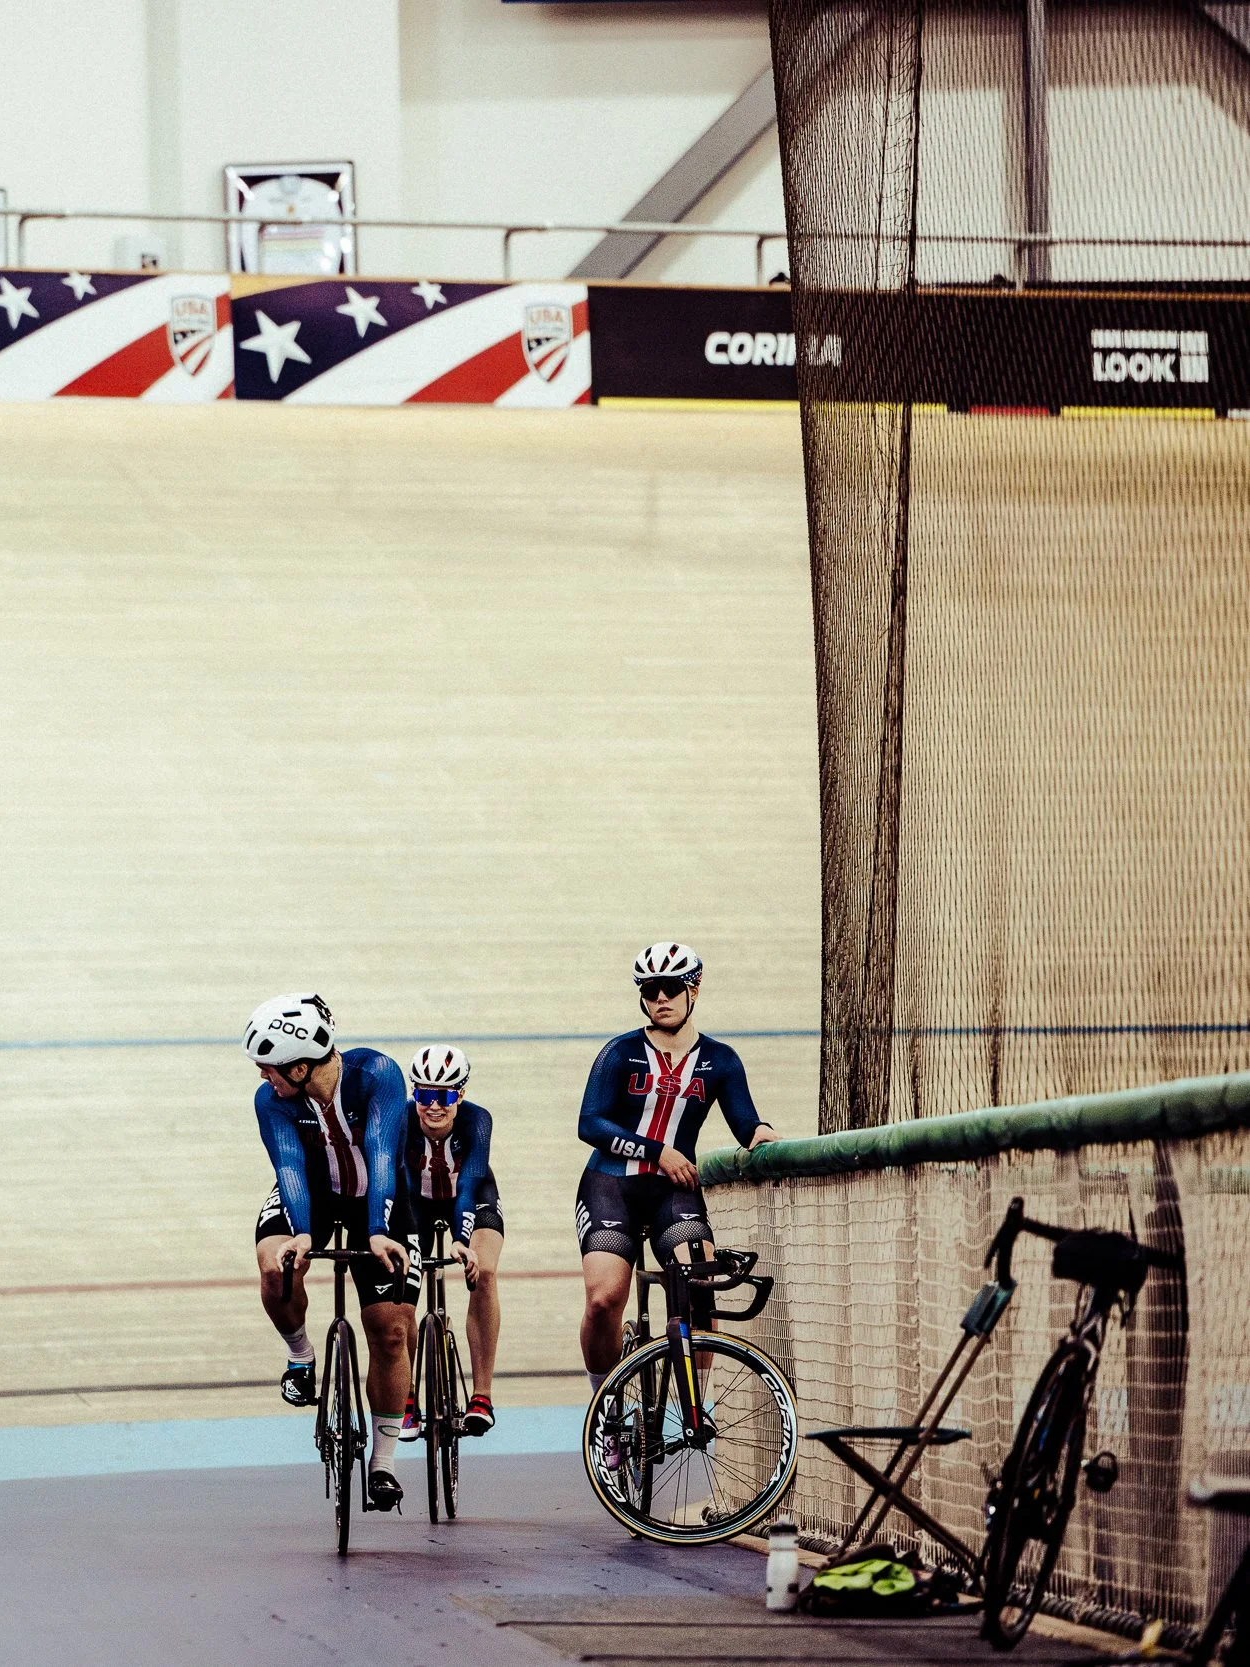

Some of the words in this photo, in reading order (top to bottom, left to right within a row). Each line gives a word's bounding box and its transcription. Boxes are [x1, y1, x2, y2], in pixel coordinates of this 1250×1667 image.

[1093, 351, 1176, 383] LOOK
[627, 1072, 706, 1103] USA
[610, 1136, 646, 1159] USA
[461, 1211, 476, 1240] USA
[406, 1233, 423, 1289] USA
[760, 1373, 792, 1481] CORIMA
